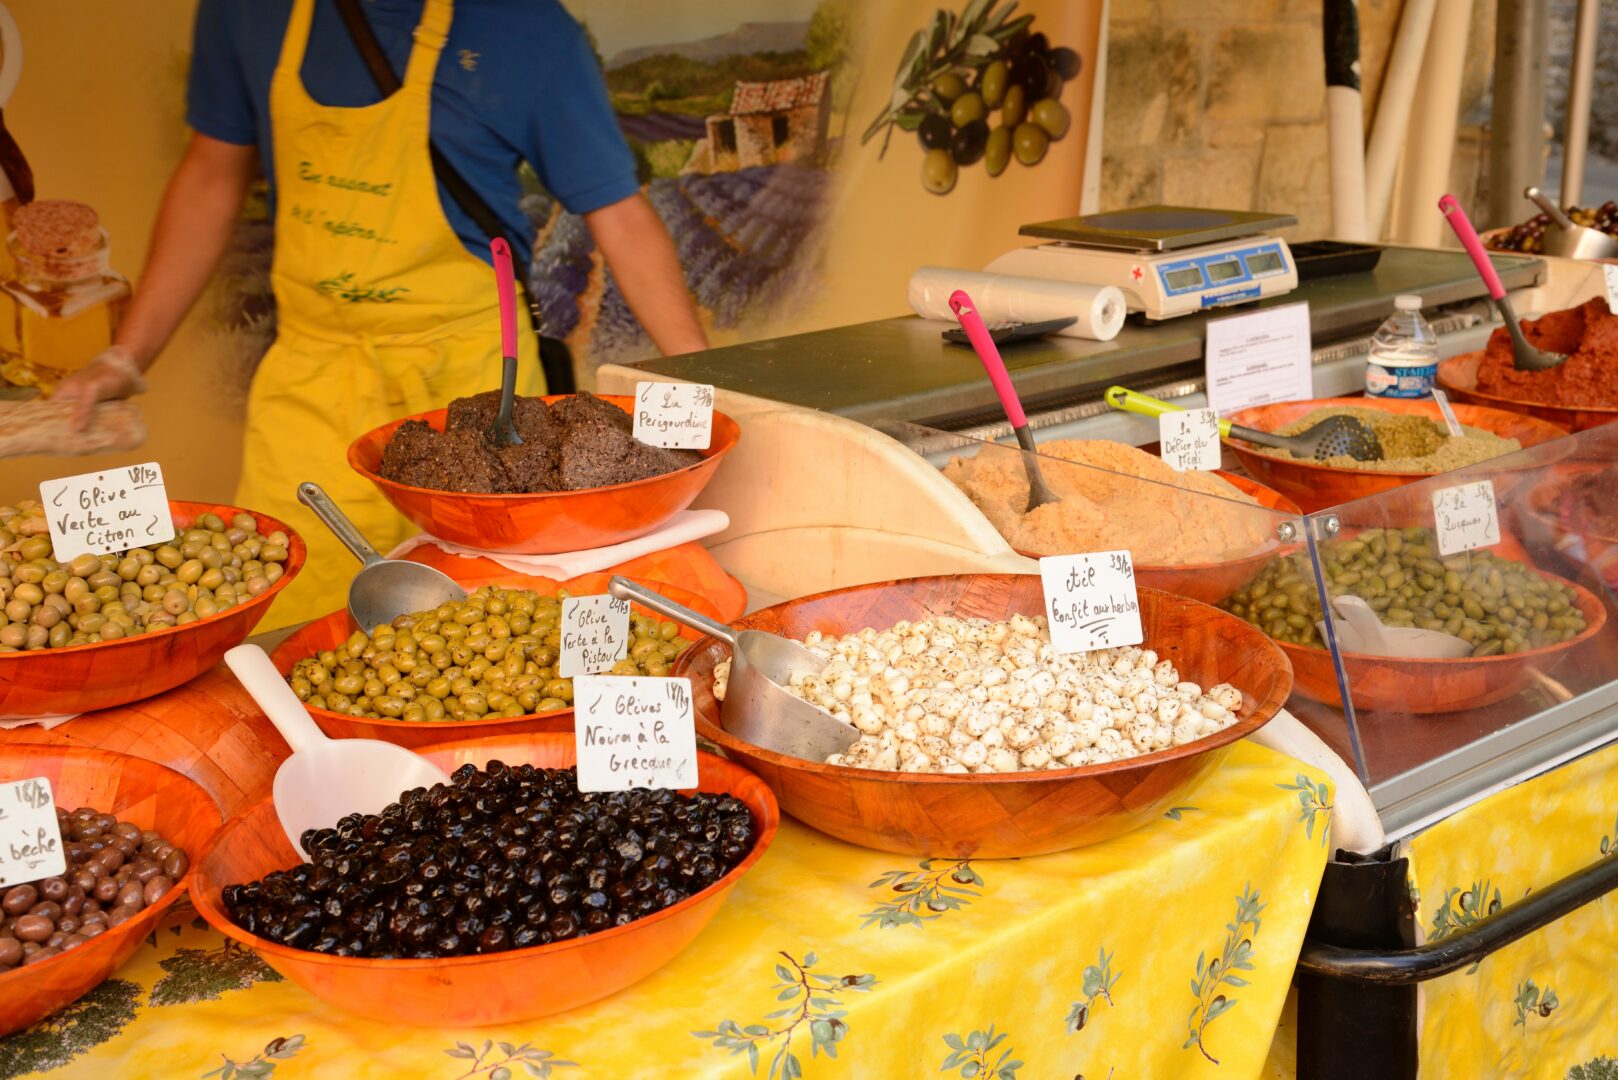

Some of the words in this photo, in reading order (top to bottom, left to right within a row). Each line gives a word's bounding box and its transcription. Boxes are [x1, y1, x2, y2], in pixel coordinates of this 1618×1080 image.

[57, 511, 110, 535] Verte
[118, 509, 141, 520] au
[86, 528, 134, 546] Citron
[578, 609, 607, 629] Olive
[563, 632, 588, 651] Verte
[591, 629, 598, 645] à
[605, 625, 616, 644] la
[582, 647, 613, 667] Pistou
[615, 694, 661, 716] Olives
[653, 720, 670, 745] la
